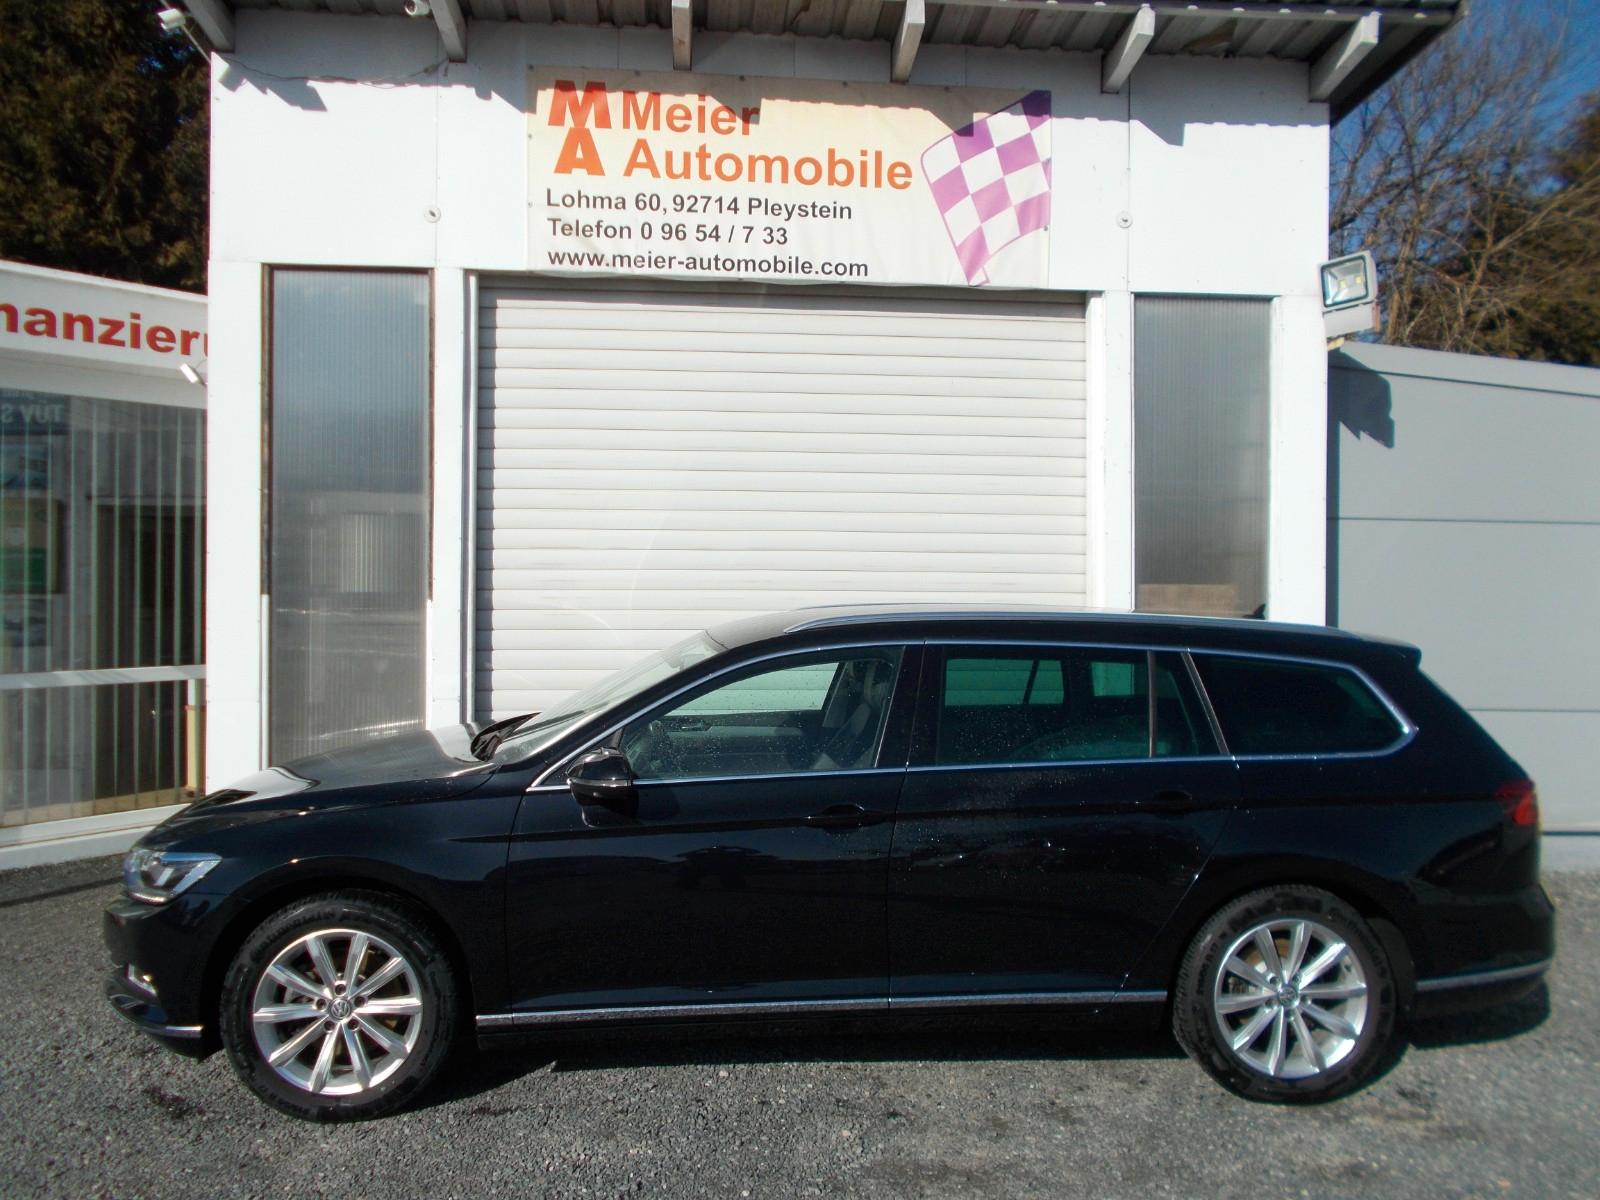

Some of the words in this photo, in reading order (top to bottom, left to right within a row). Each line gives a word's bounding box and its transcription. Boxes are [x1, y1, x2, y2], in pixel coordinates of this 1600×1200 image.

[622, 89, 761, 136] Meier
[623, 138, 913, 191] Automobile
[546, 188, 627, 210] Lohma
[748, 196, 852, 222] Pleystein
[547, 217, 632, 239] Telefon
[640, 221, 653, 240] 0
[661, 222, 687, 241] 96
[695, 224, 721, 242] 54
[742, 225, 754, 243] 7
[762, 226, 788, 245] 33
[547, 251, 869, 277] www.meier-automobile.com
[0, 302, 208, 357] nanzier
